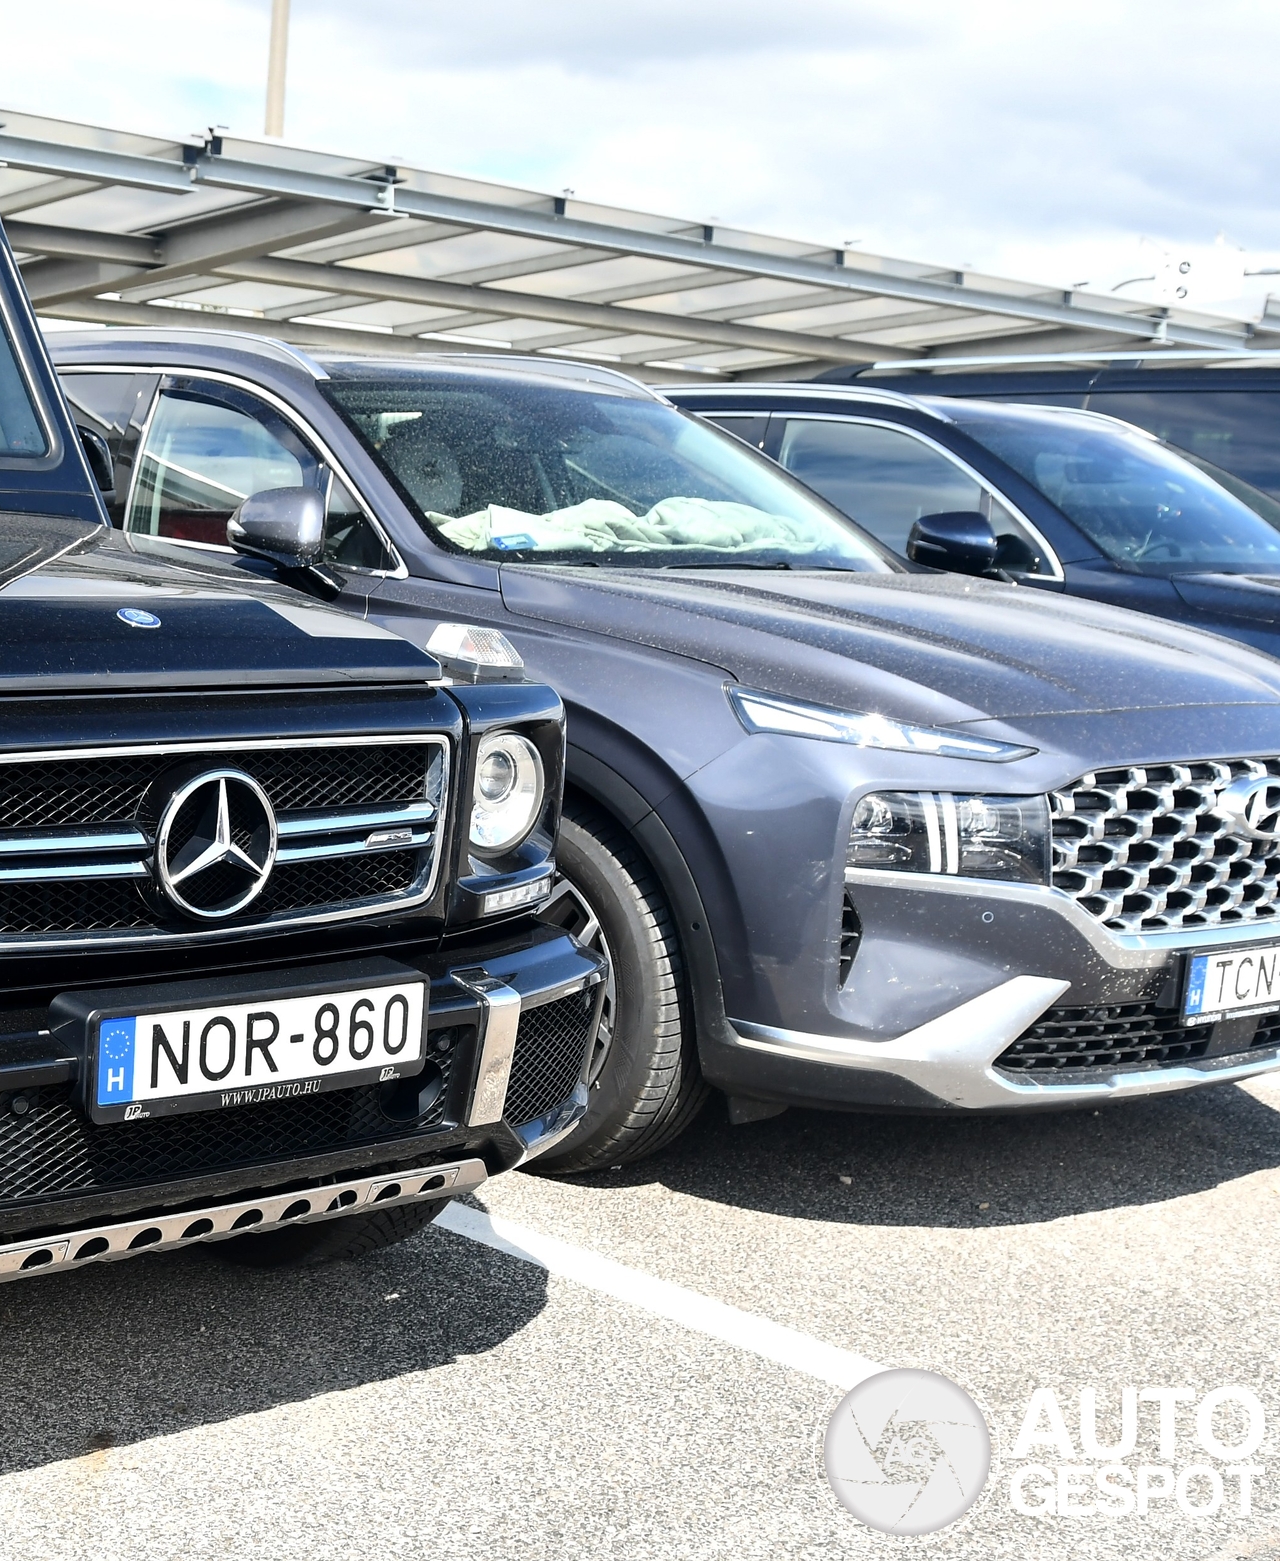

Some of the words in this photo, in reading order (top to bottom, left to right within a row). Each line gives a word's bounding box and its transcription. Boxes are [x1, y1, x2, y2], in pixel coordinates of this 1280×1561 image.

[1190, 990, 1201, 1006] H
[1216, 954, 1280, 1002] TCN
[106, 1066, 125, 1093] H
[149, 993, 410, 1089] NOR-860
[220, 1079, 322, 1107] WWW.JPAUTO.HU
